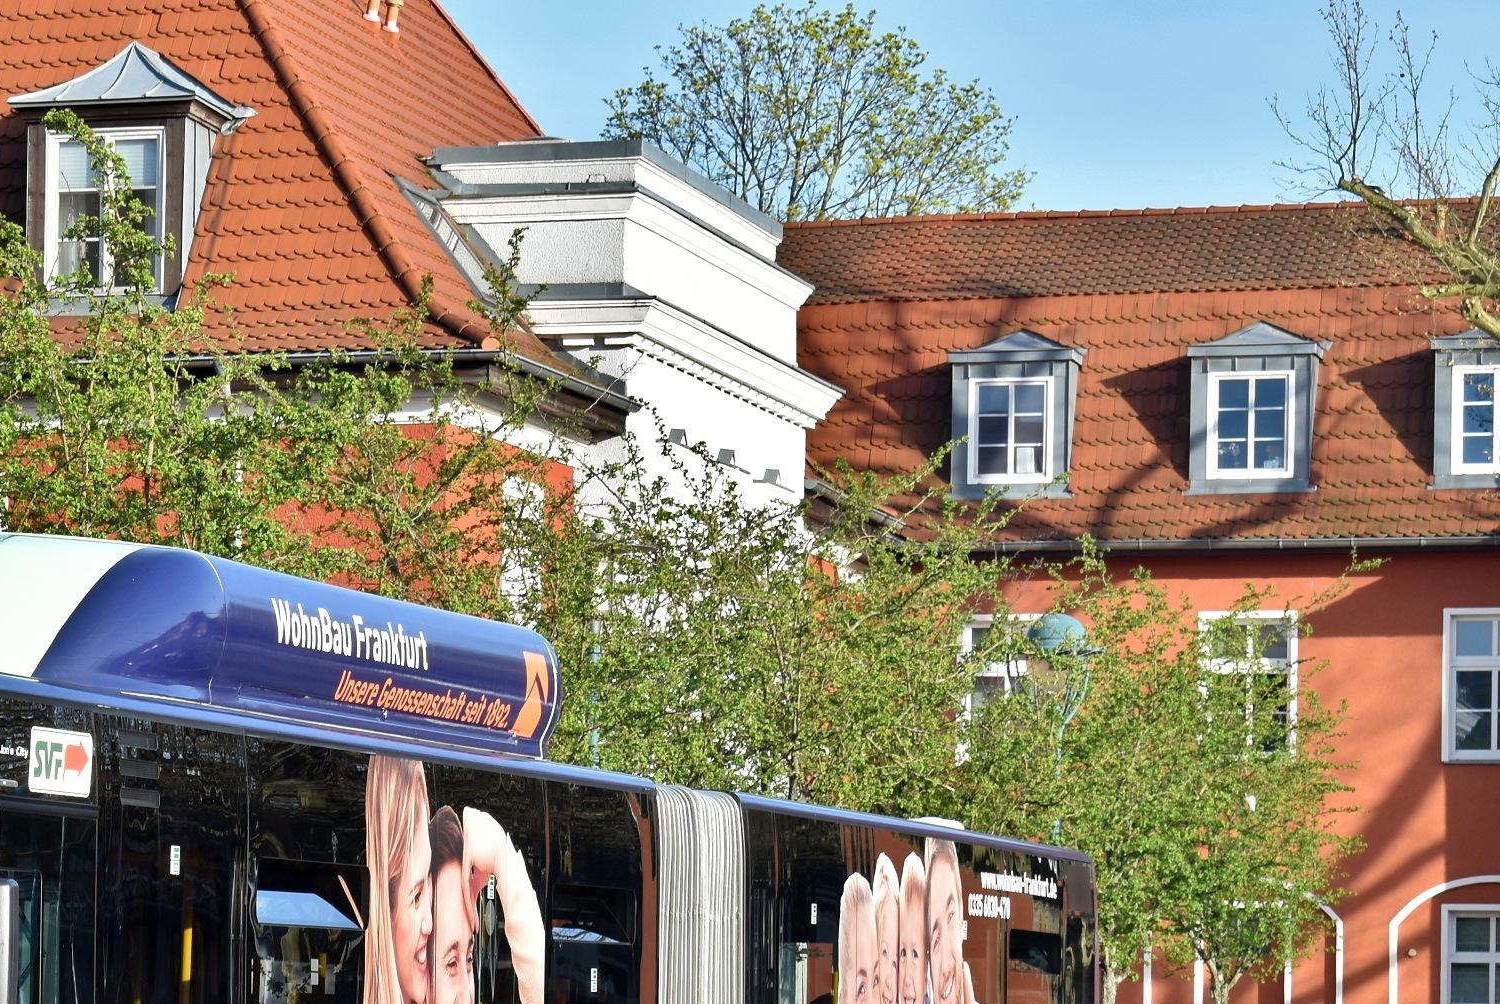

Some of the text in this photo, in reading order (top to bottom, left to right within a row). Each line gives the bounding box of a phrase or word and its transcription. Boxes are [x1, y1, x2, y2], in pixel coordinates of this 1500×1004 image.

[271, 598, 429, 671] WohnBau Frankfurt
[334, 670, 511, 729] Unsere Genossenschaft seit 1892.
[16, 745, 29, 760] City
[33, 740, 63, 781] SVF
